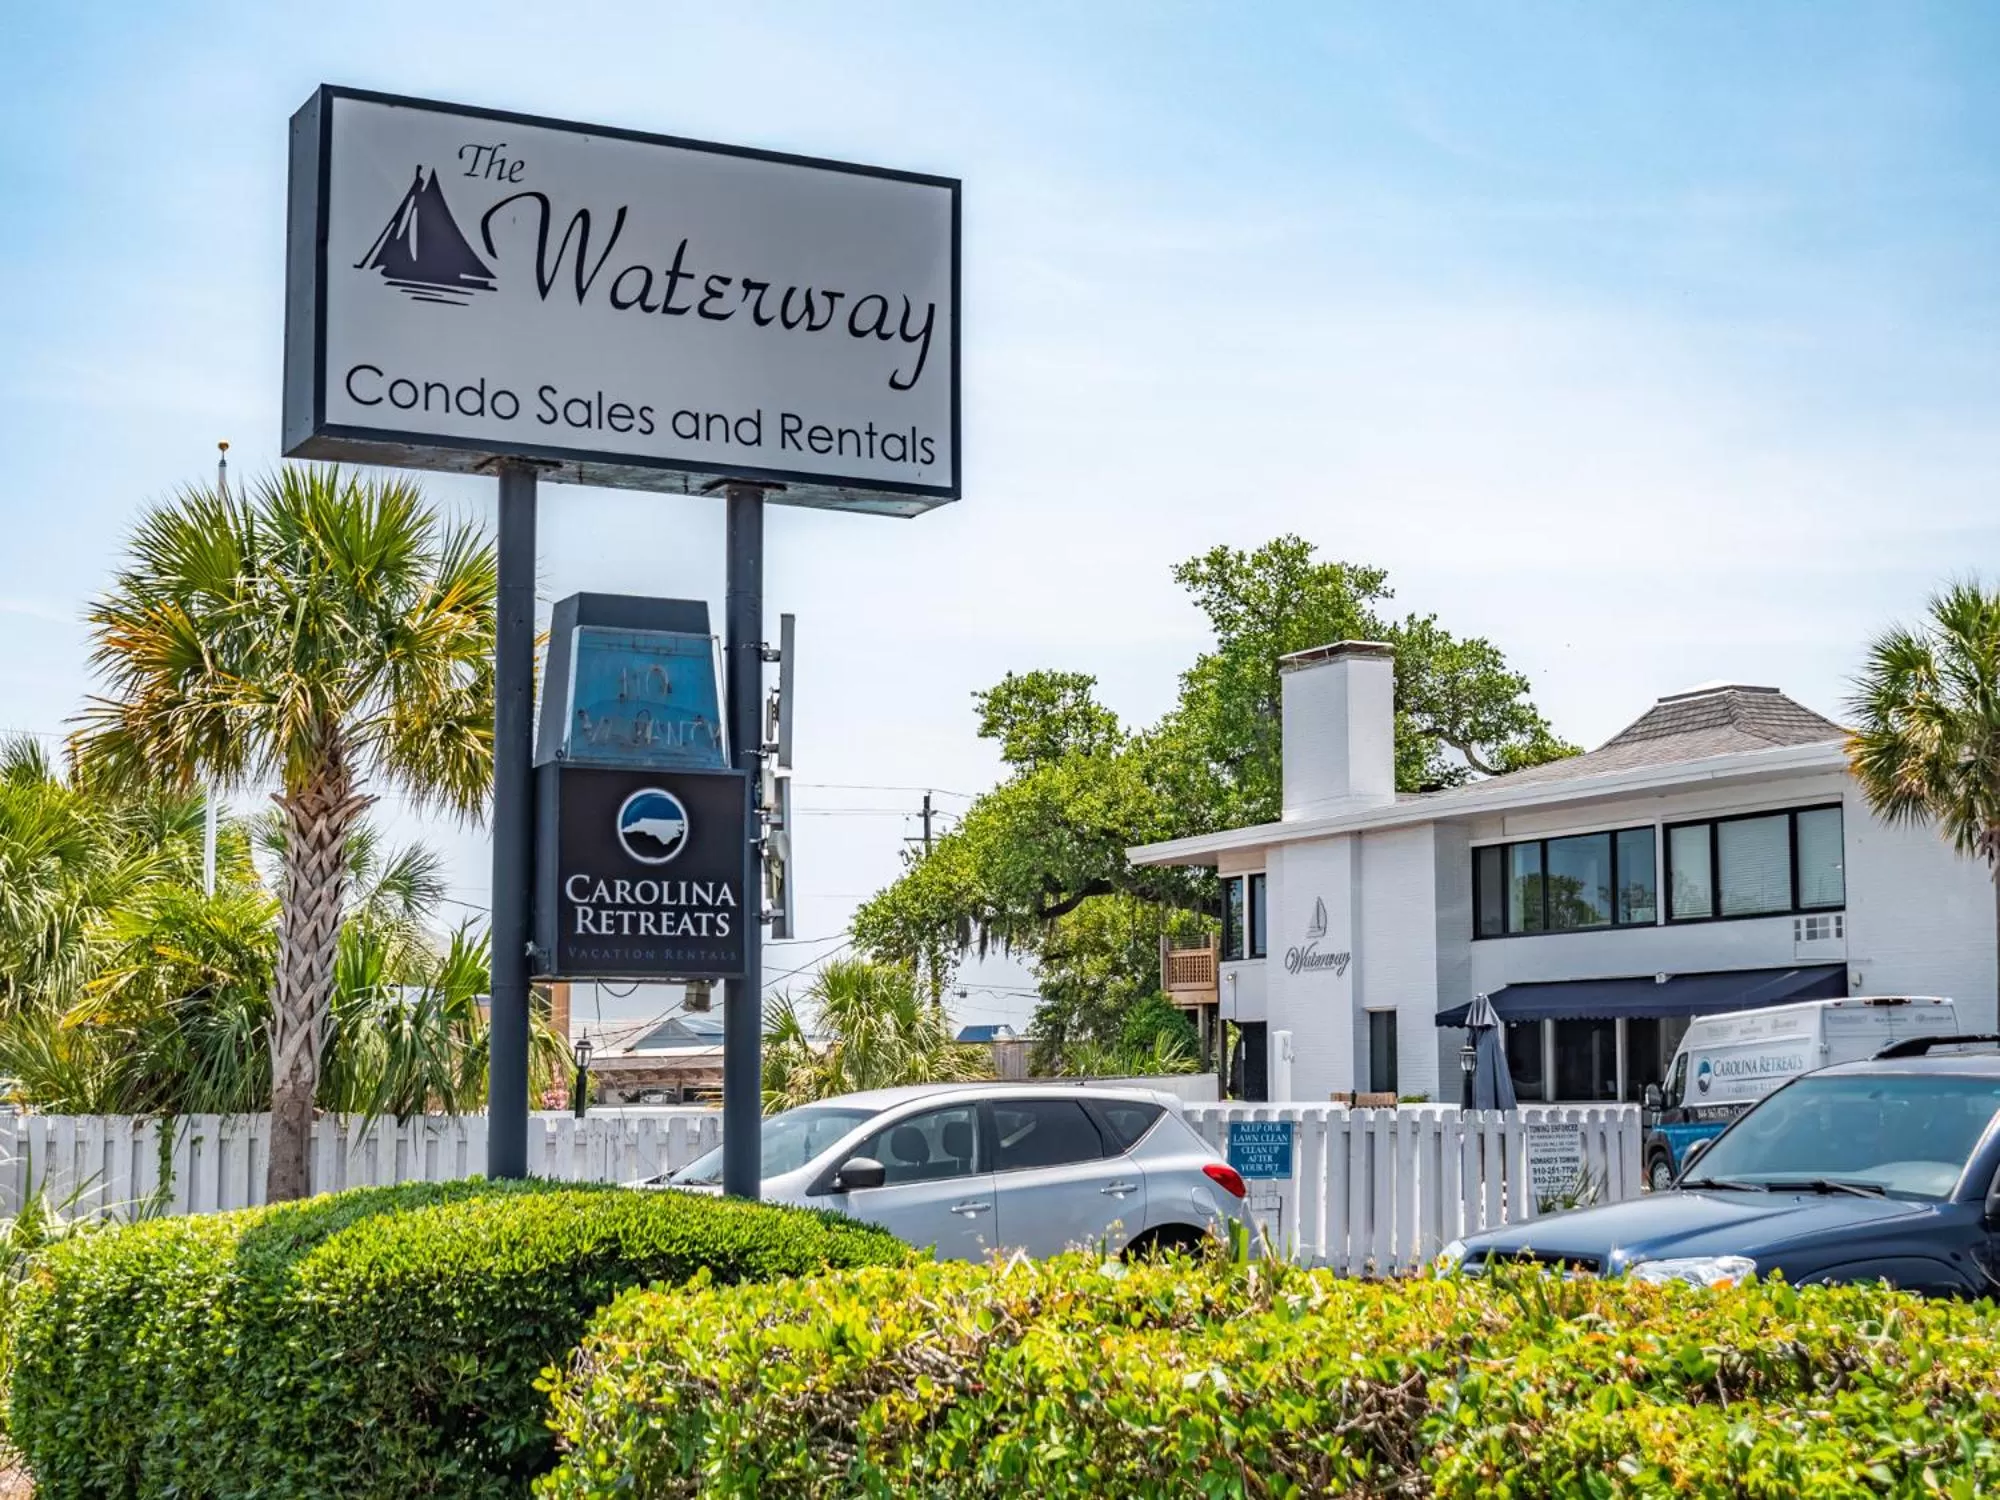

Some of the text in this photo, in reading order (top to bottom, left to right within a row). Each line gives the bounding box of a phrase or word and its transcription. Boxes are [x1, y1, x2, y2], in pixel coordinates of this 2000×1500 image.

[458, 142, 525, 184] The
[480, 190, 936, 392] Waterway
[345, 363, 936, 466] Condo Sales and Rentals
[565, 873, 737, 907] CAROLINA
[574, 905, 731, 937] RETREATS
[1284, 940, 1352, 977] Waterway
[1233, 1133, 1288, 1142] LAWN CLEAN
[1240, 1146, 1280, 1154] CLEAN UP
[1240, 1163, 1279, 1172] YOUR PET
[1248, 1154, 1273, 1163] AFTER
